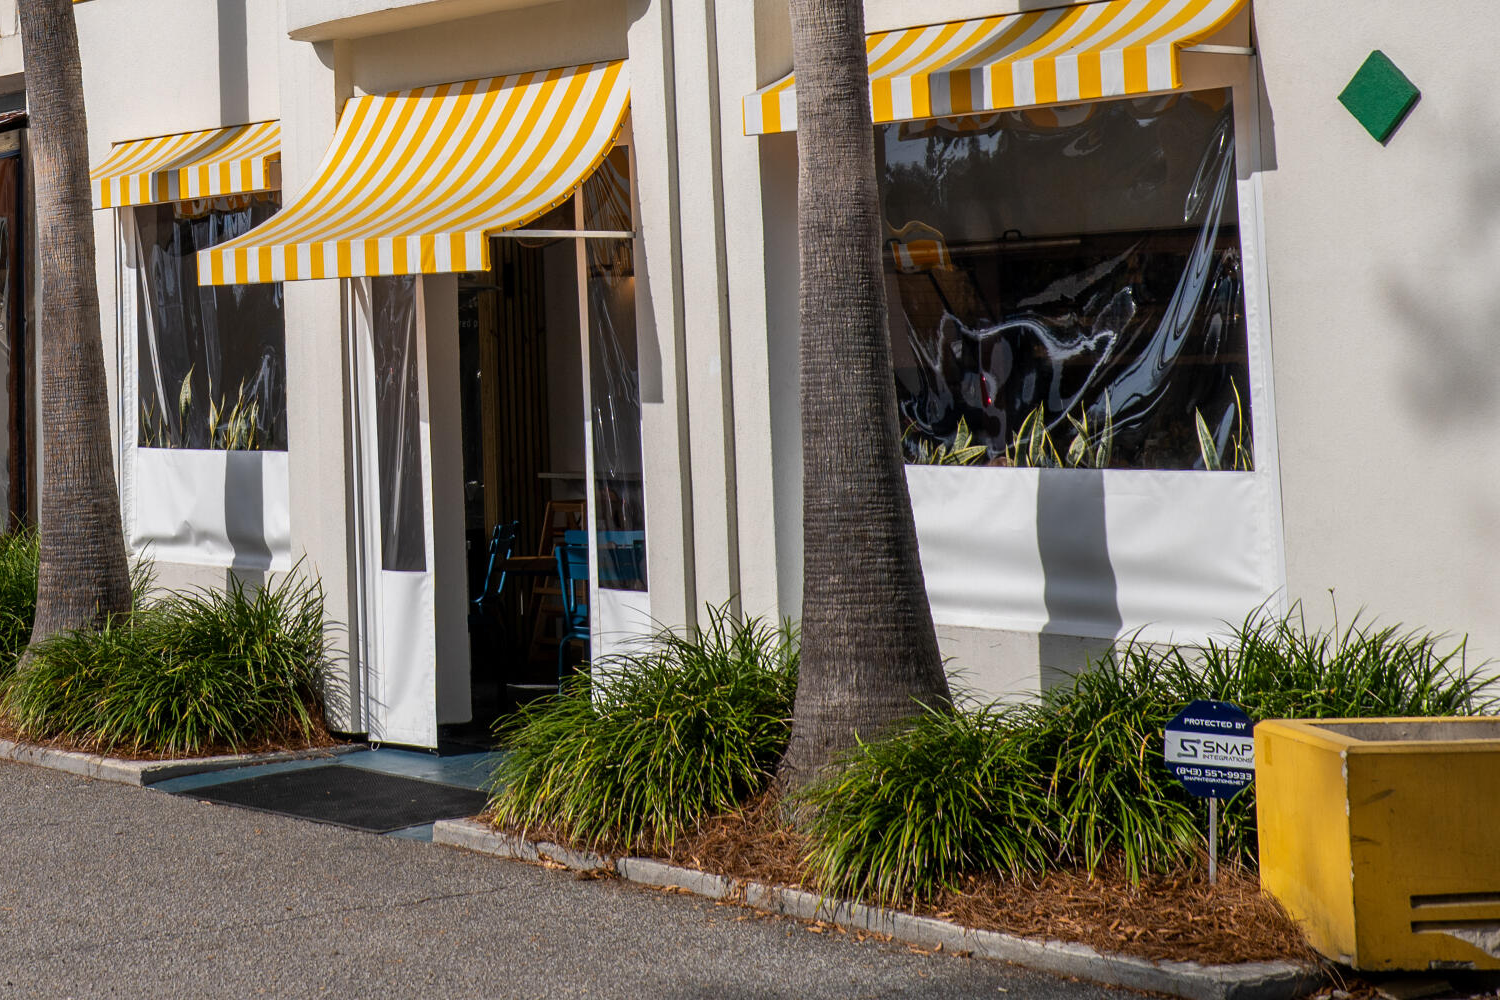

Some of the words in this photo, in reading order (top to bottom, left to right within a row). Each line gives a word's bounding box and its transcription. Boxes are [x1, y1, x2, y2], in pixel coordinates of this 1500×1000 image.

[1184, 718, 1233, 728] PROTECTED
[1235, 722, 1246, 730] BY
[1203, 741, 1252, 756] SNAP
[1202, 754, 1253, 764] INTEGRATIONS
[1176, 766, 1202, 777] (843)
[1205, 769, 1252, 781] 557-9933
